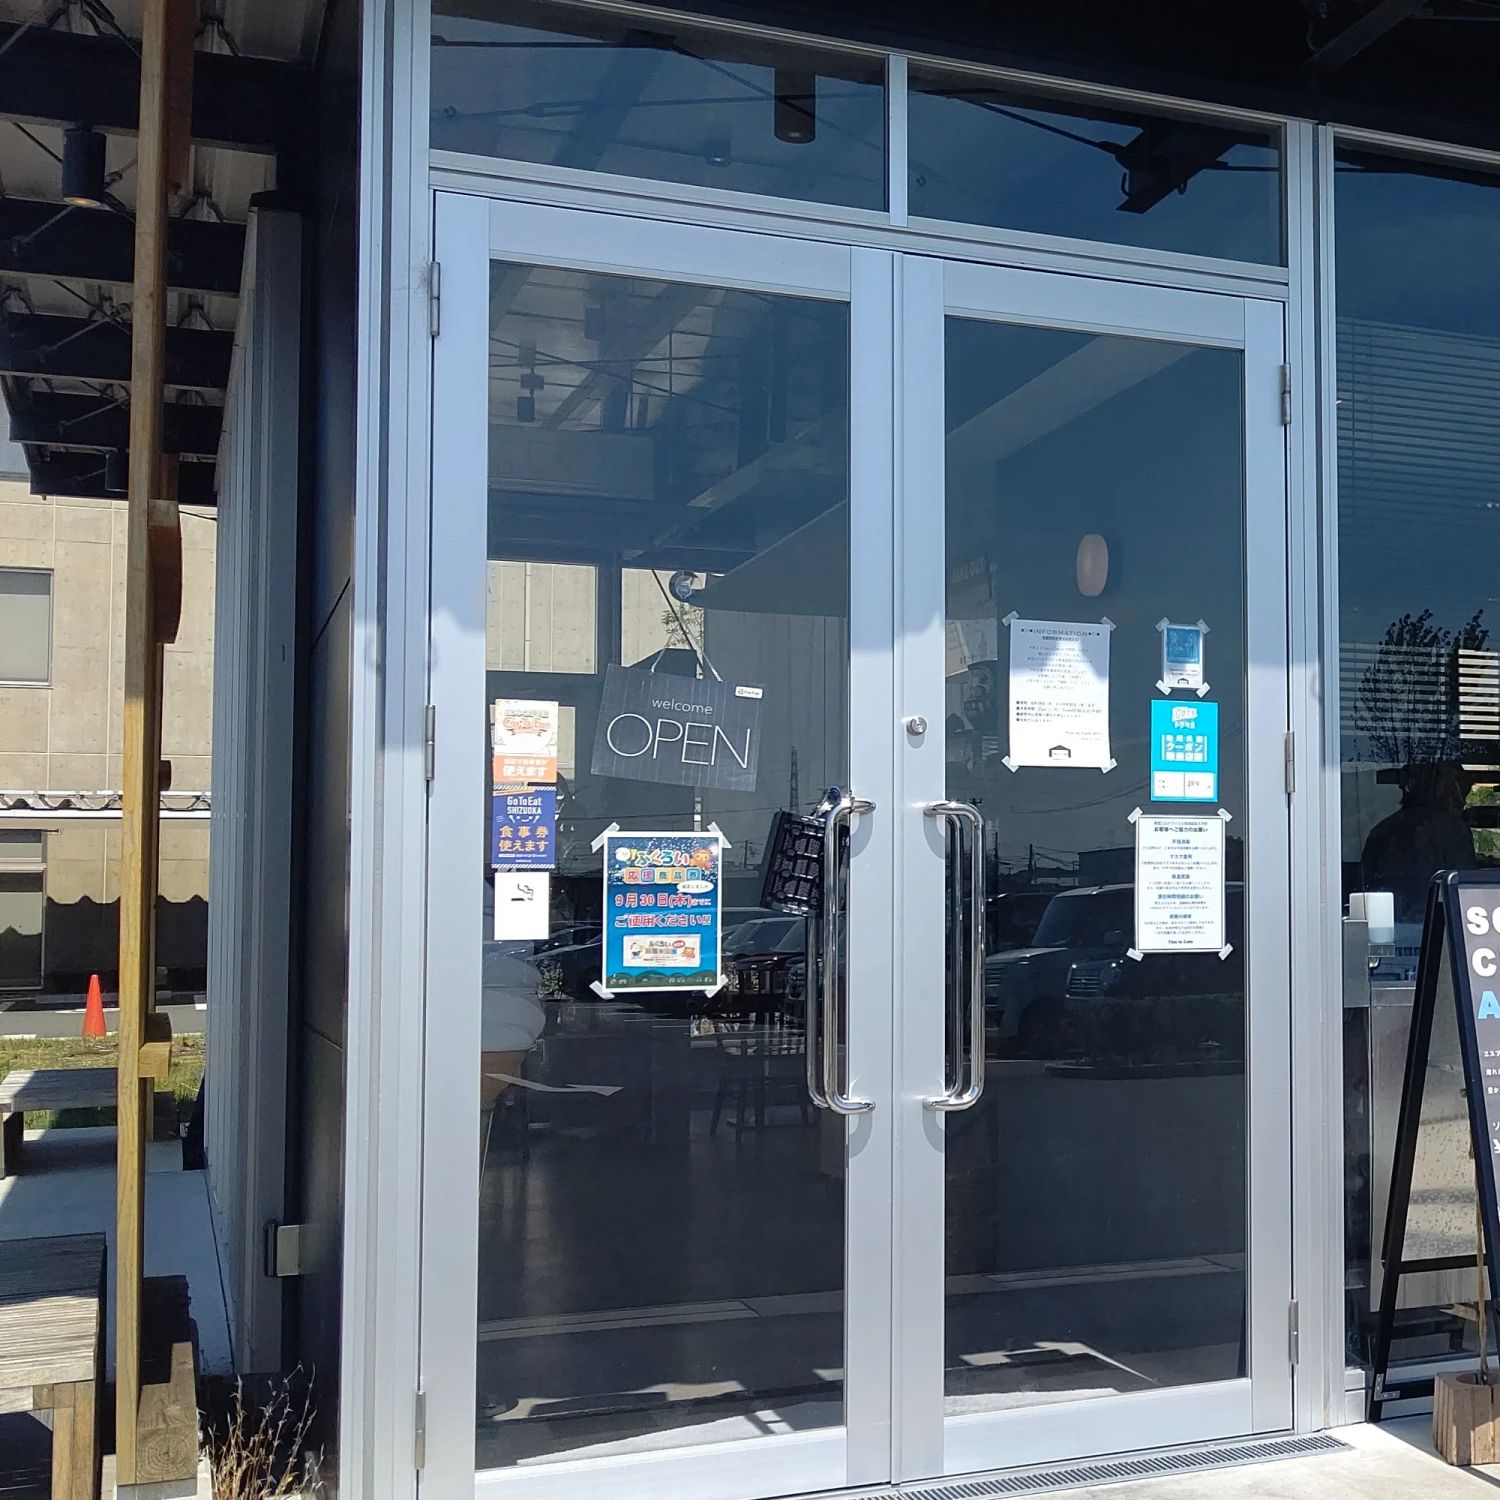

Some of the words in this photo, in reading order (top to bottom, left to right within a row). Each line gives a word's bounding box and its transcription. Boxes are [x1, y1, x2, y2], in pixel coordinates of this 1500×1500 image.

[1034, 629, 1088, 637] INFORMATION
[652, 699, 713, 715] welcome
[607, 713, 751, 769] OPEN
[499, 840, 549, 852] 使えます
